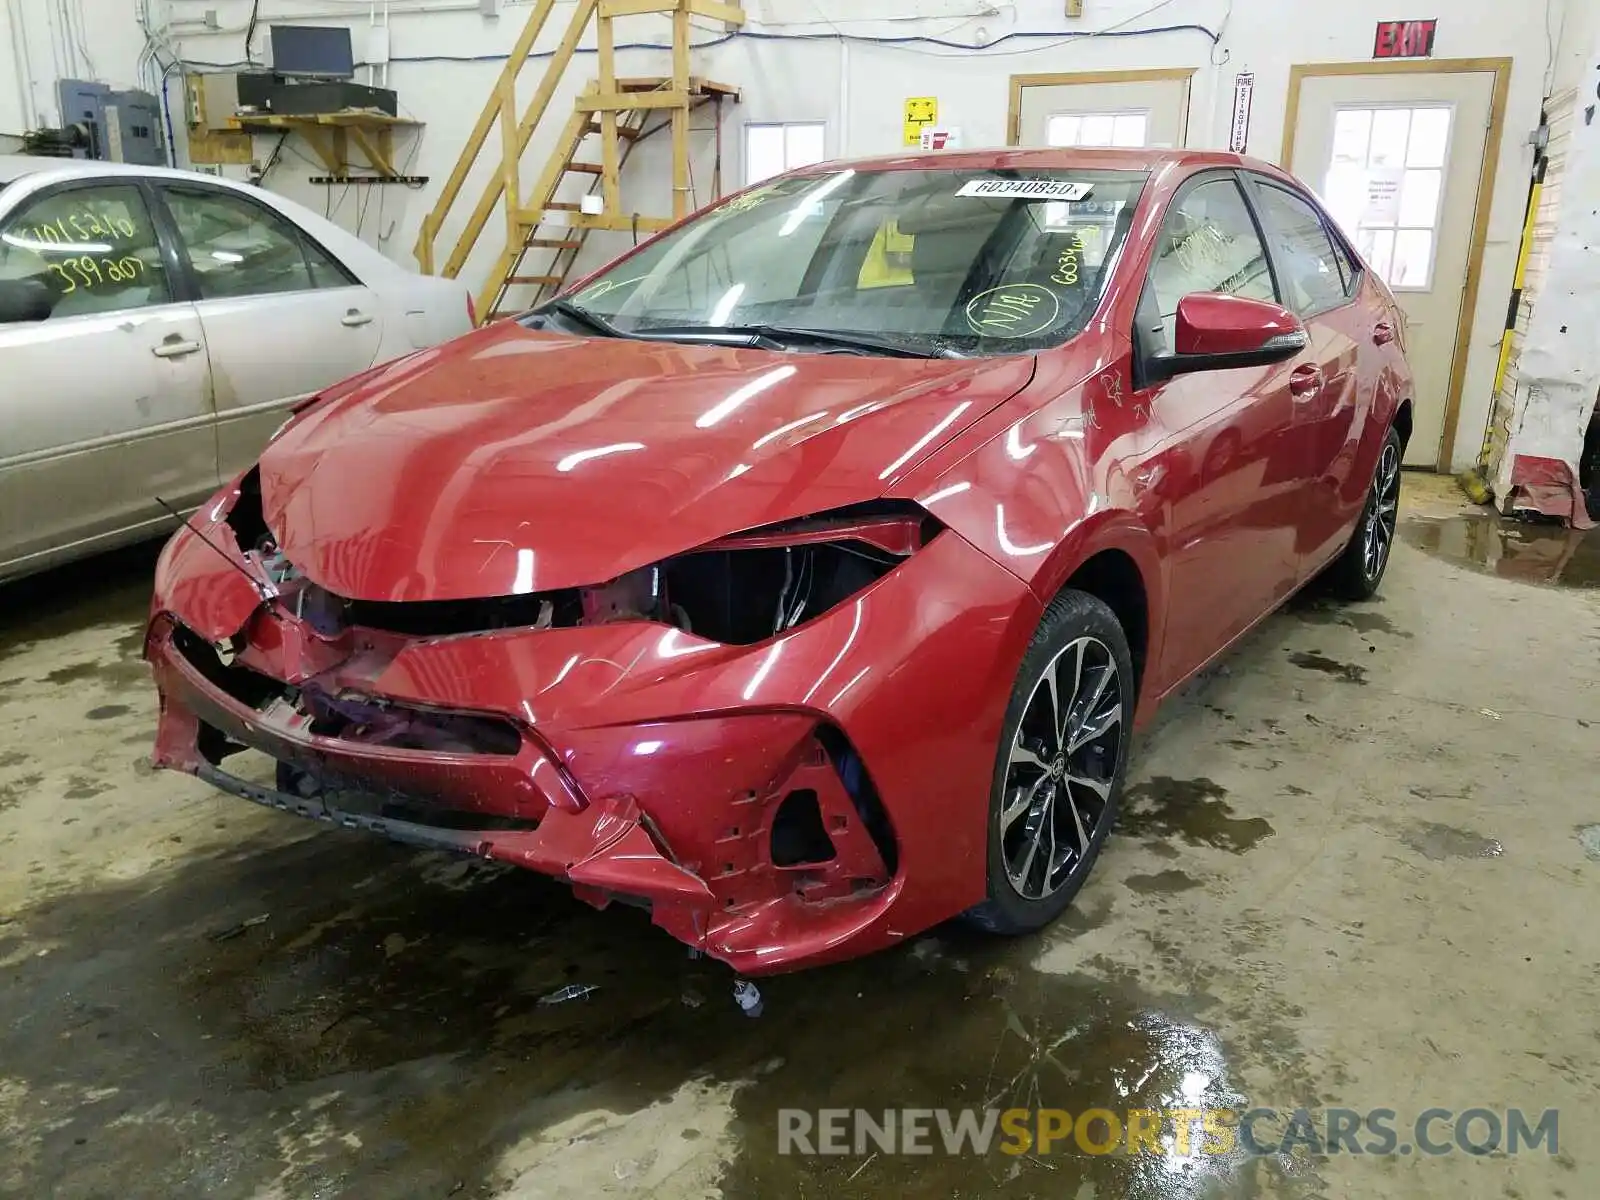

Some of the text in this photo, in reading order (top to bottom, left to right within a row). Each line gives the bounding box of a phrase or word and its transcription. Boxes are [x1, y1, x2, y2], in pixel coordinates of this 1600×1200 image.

[1375, 21, 1434, 57] EXIT
[1237, 78, 1252, 87] FIRE
[1235, 87, 1247, 152] EXTINGUISHER
